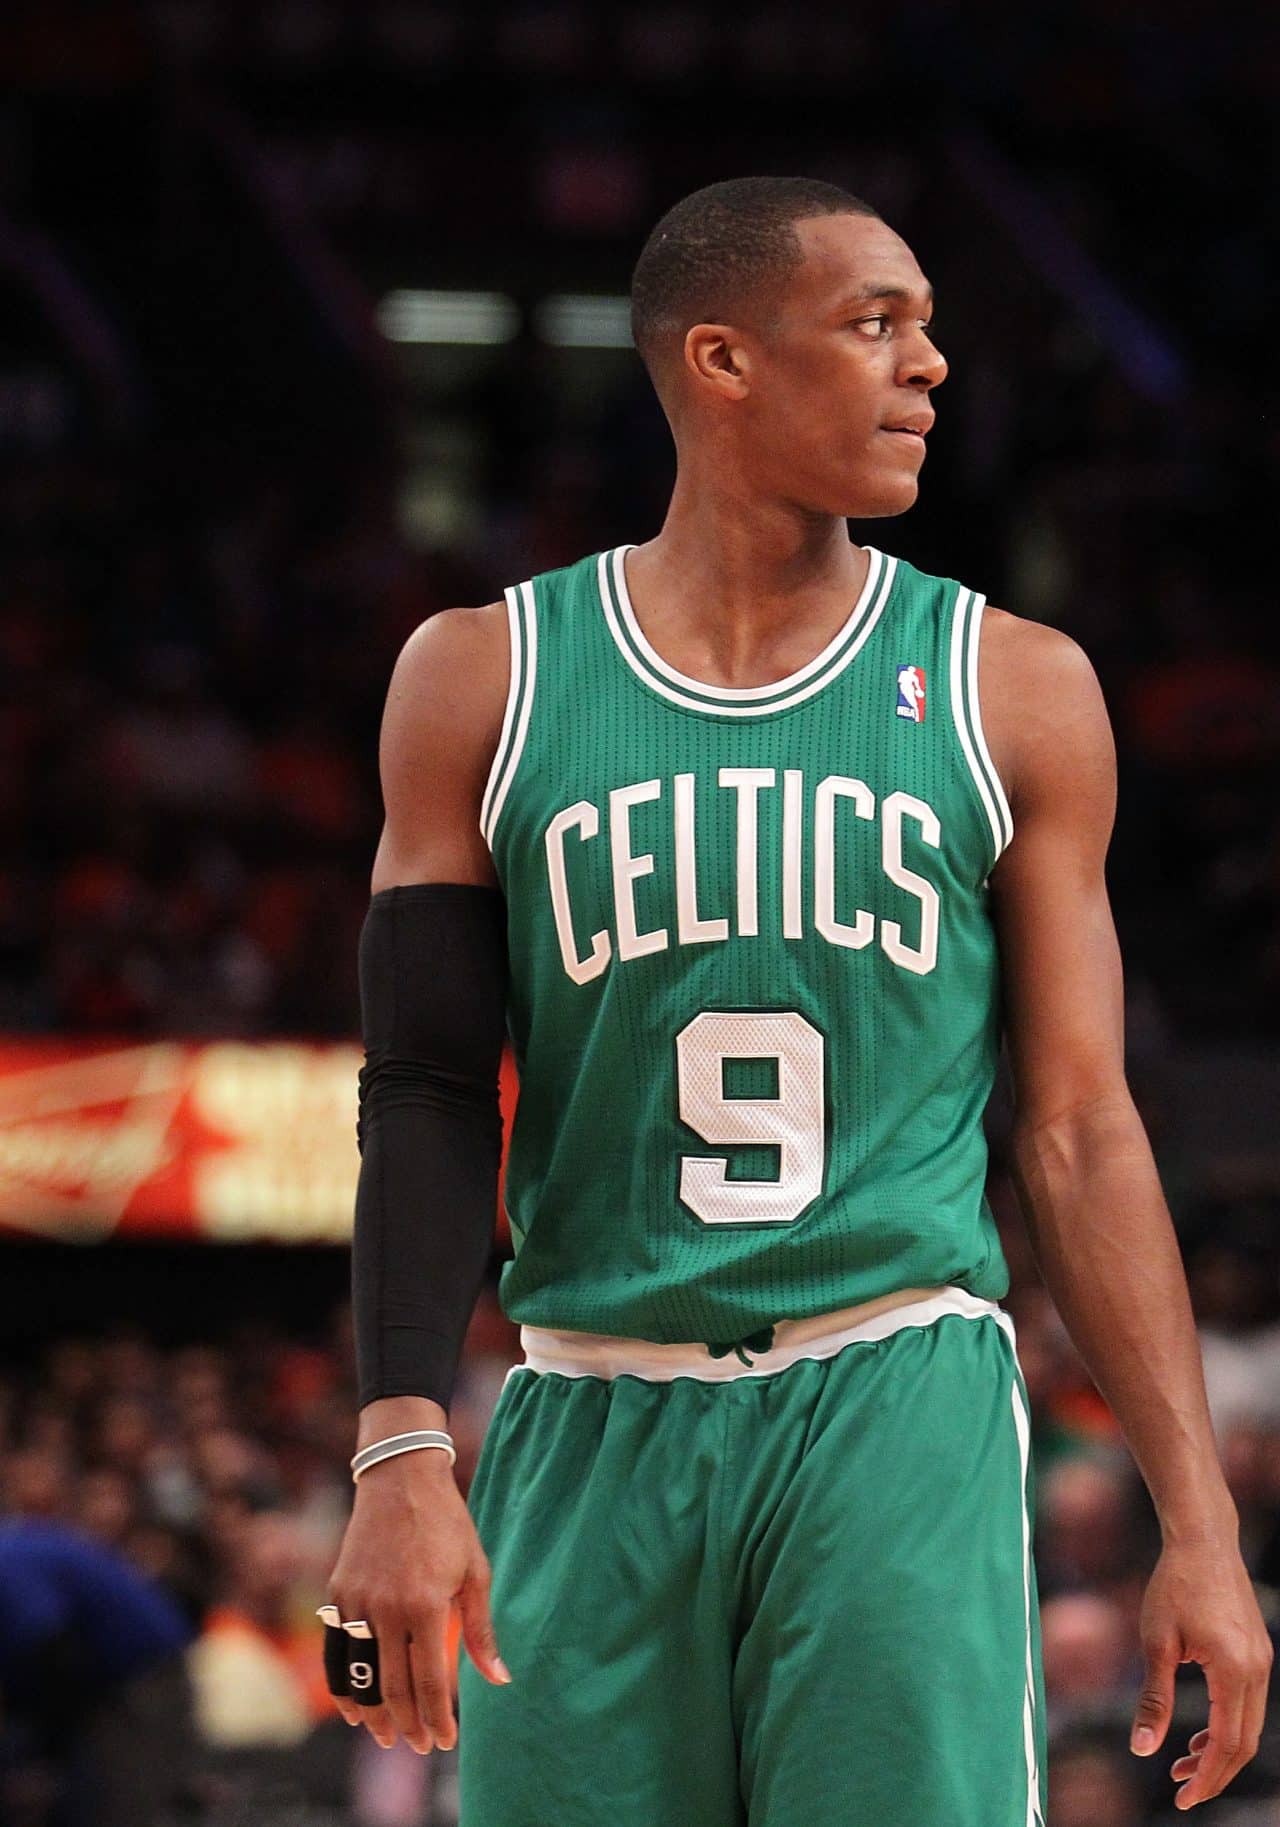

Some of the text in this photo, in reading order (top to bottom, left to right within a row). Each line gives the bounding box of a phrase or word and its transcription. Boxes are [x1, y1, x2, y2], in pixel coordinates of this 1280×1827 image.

[545, 768, 941, 985] CELTICS
[676, 1012, 825, 1224] 9
[350, 1662, 373, 1689] 9
